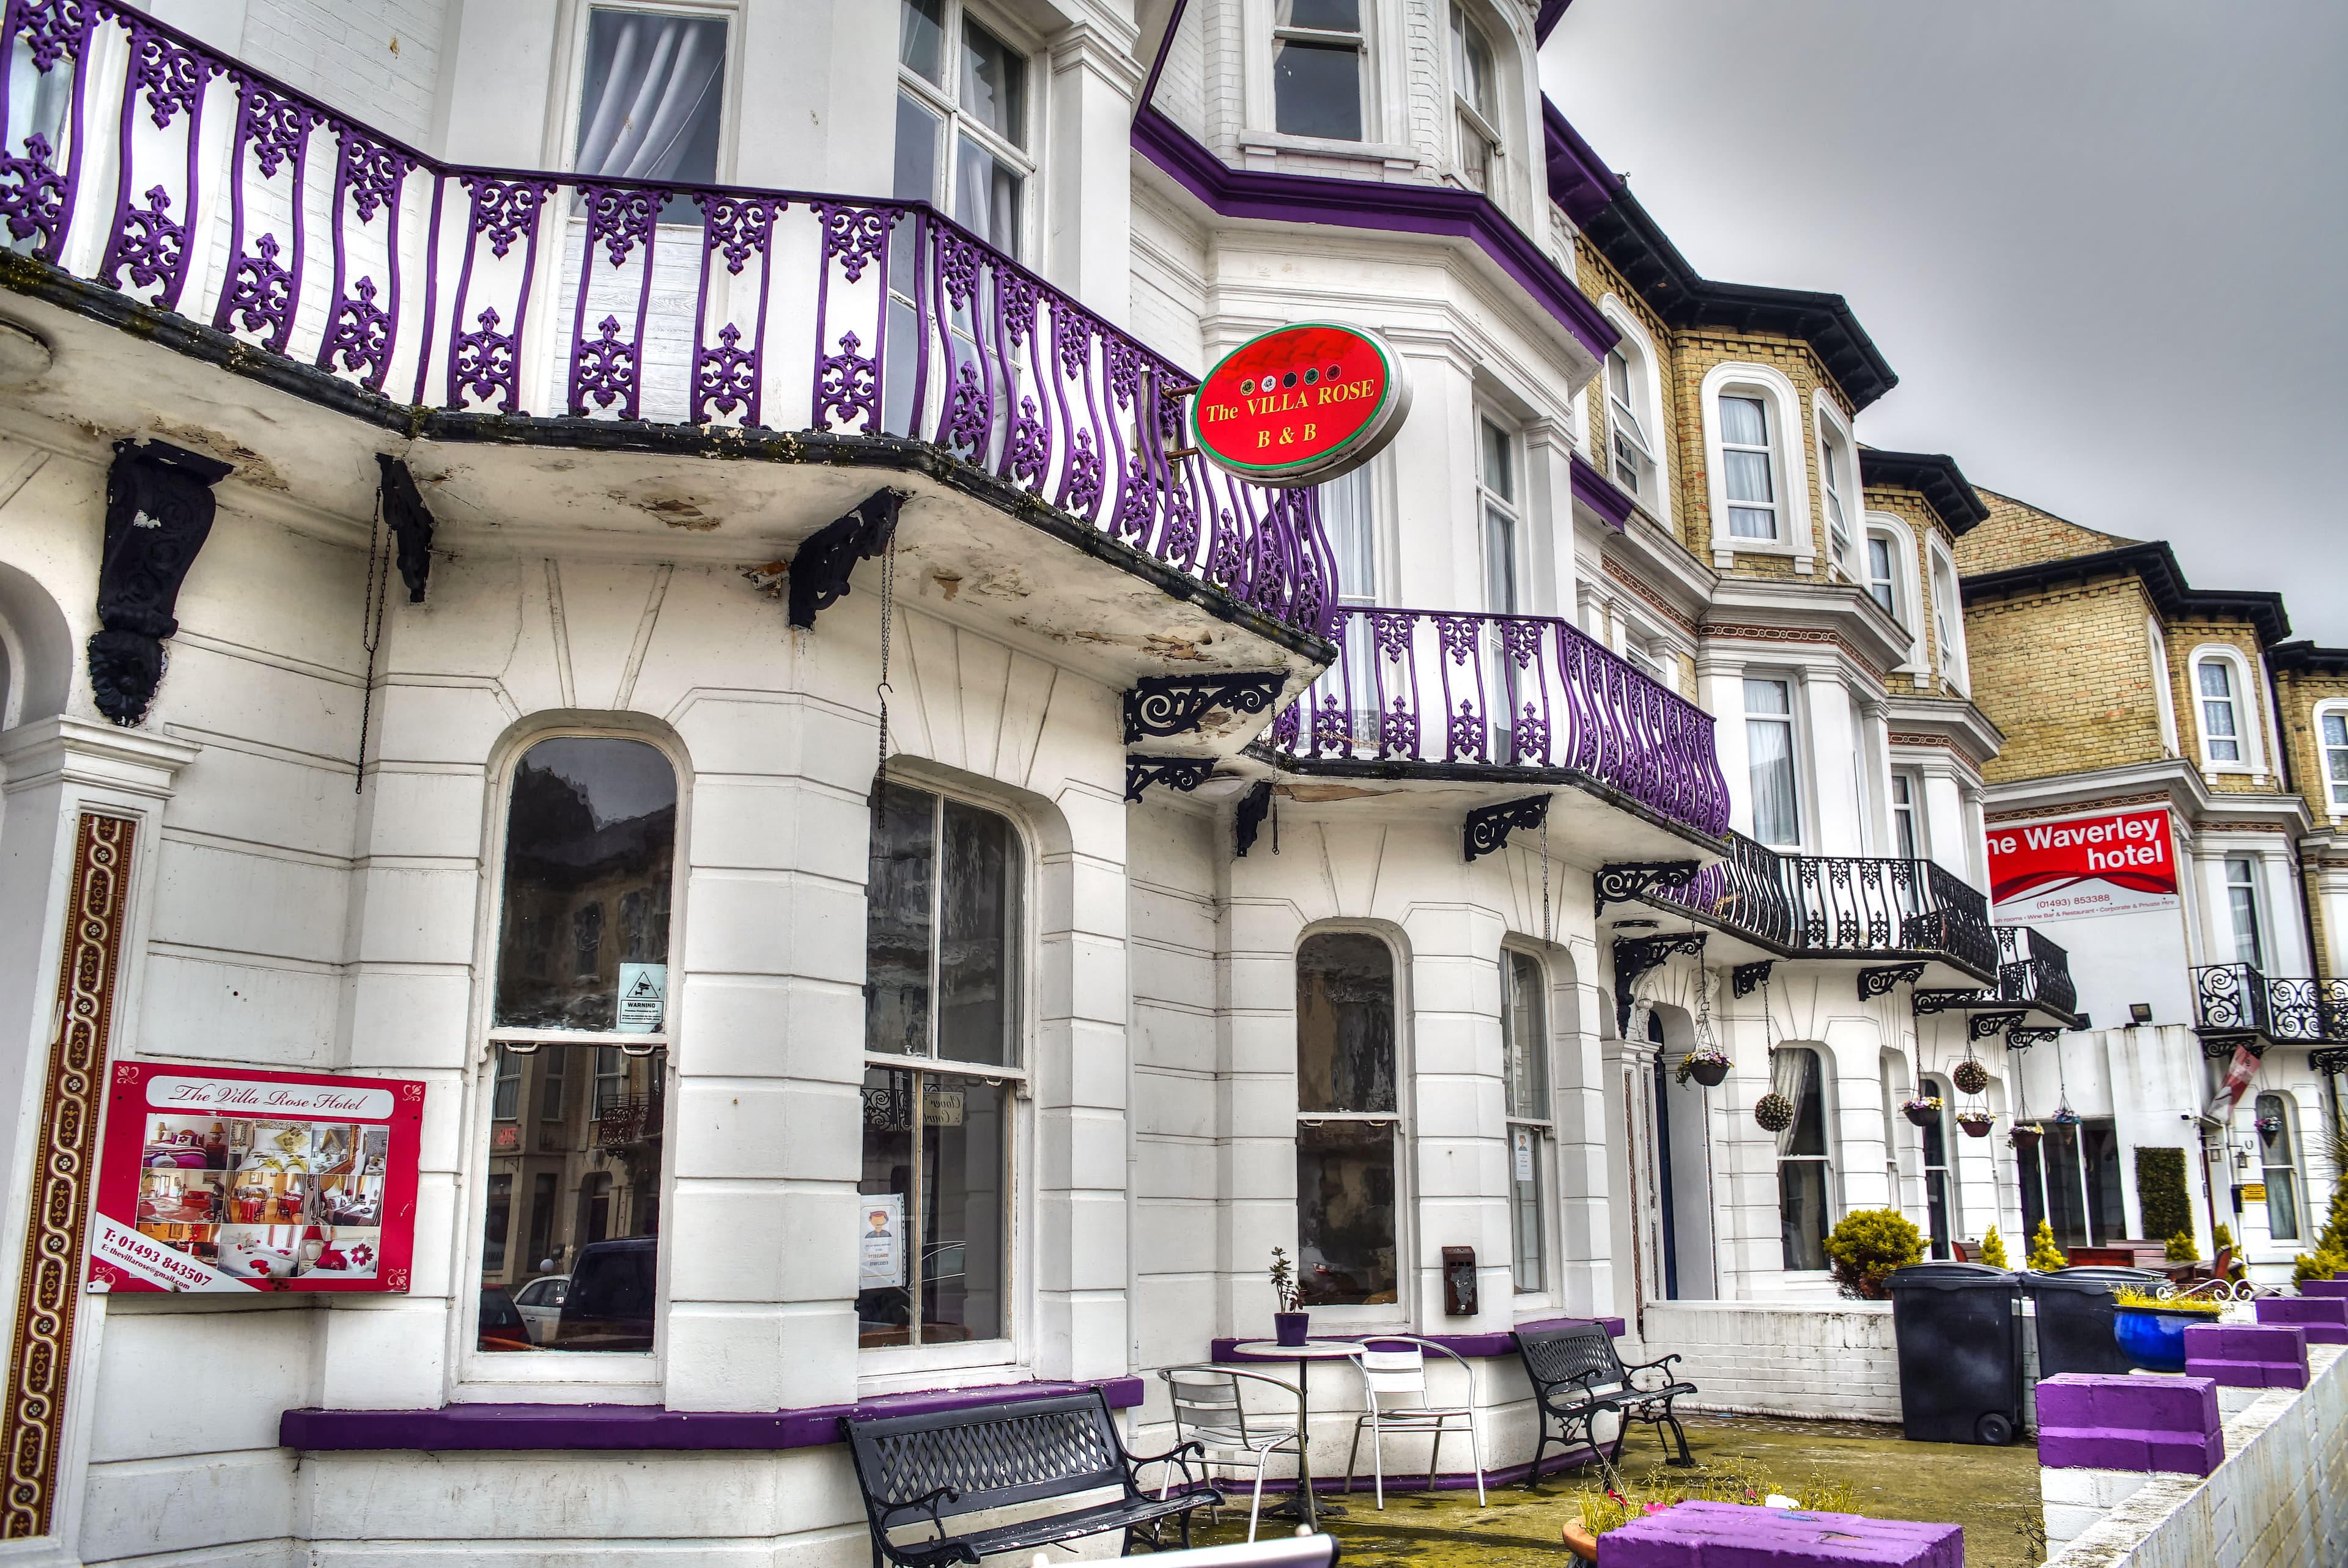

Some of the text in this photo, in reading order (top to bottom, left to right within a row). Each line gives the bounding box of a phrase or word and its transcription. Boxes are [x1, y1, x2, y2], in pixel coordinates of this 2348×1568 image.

[1206, 378, 1375, 422] The VILLA ROSE
[1257, 423, 1317, 449] B & B
[2024, 817, 2160, 851] Waverley
[2087, 840, 2163, 870] hotel
[2037, 894, 2110, 910] (01493) 853388
[2062, 908, 2094, 916] Restaurant
[169, 1083, 369, 1111] The Villa Rose Hotel
[103, 1228, 213, 1286] T: 01493 843507
[109, 1247, 190, 1290] thevillarose@gmail.com
